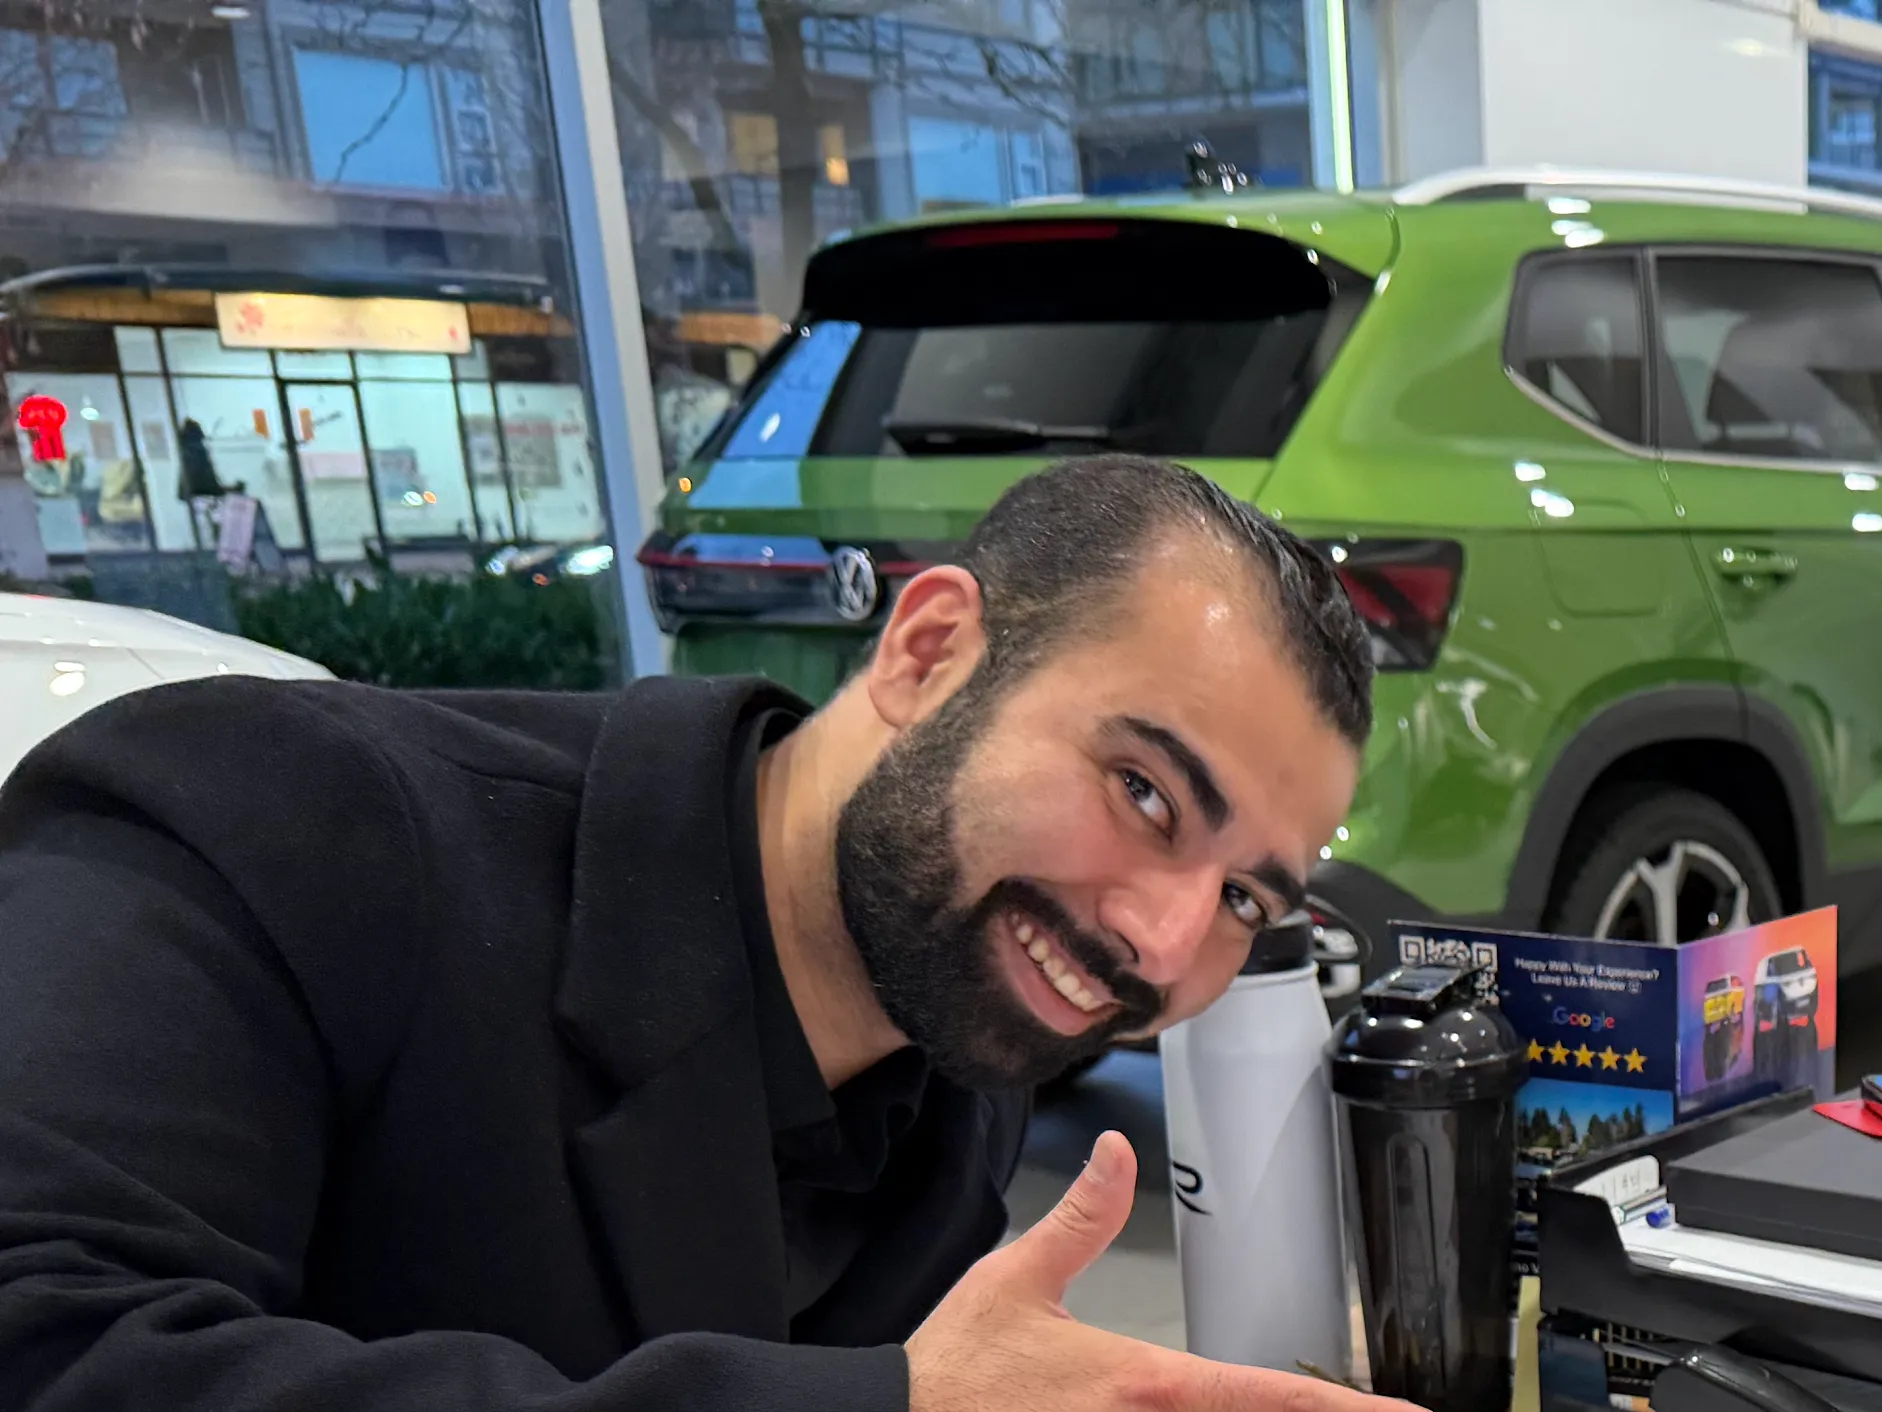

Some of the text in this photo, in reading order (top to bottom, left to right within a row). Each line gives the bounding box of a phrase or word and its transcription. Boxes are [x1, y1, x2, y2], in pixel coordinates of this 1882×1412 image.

[1514, 957, 1660, 980] Happy With Your Experience?
[1530, 972, 1626, 991] Leave Us A Review
[1553, 1006, 1616, 1032] Google
